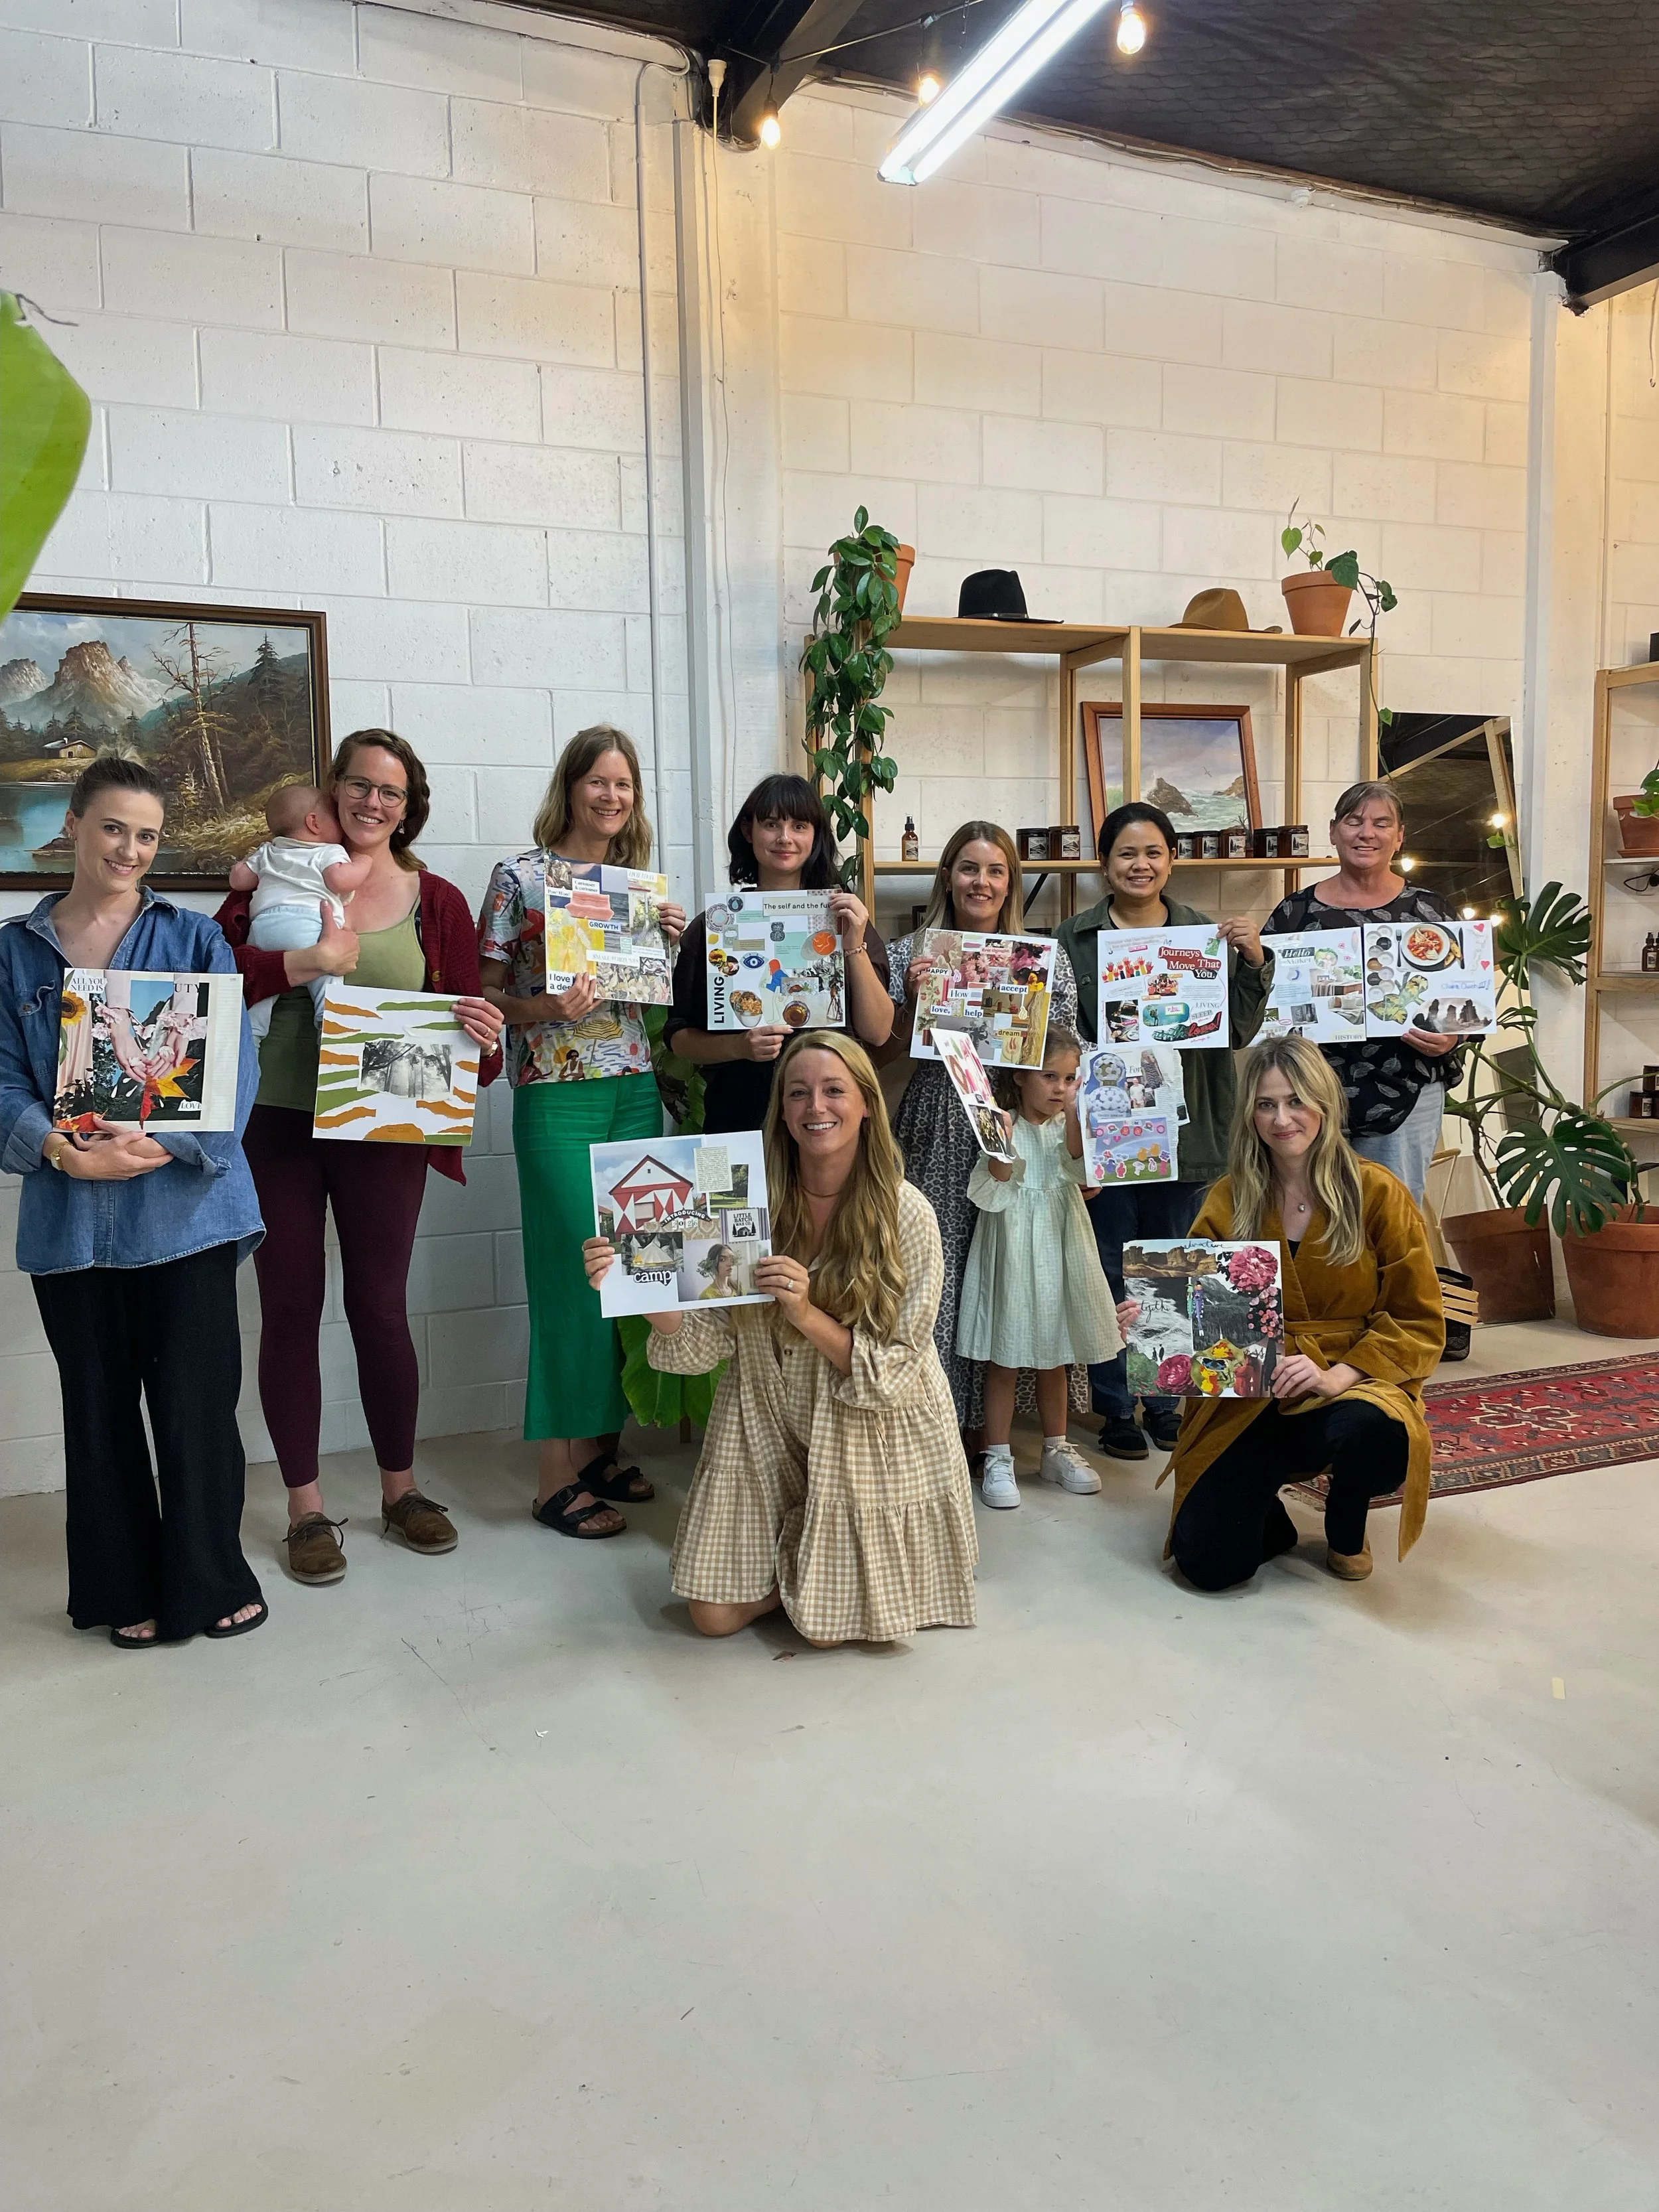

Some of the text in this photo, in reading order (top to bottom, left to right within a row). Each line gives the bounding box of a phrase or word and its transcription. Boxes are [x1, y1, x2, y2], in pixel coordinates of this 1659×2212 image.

[589, 921, 618, 930] GROWTH
[1159, 946, 1200, 959] Journeys
[1284, 948, 1311, 958] Hello
[1169, 958, 1220, 970] Move That
[553, 974, 571, 982] love
[1194, 969, 1215, 978] You.
[950, 989, 969, 998] How
[1000, 985, 1028, 994] accept
[713, 976, 725, 1024] LIVING
[931, 1005, 951, 1015] love,
[965, 1009, 983, 1018] help
[180, 1101, 202, 1110] LOVE
[664, 1210, 705, 1223] INTRODUCING
[634, 1270, 672, 1285] camp
